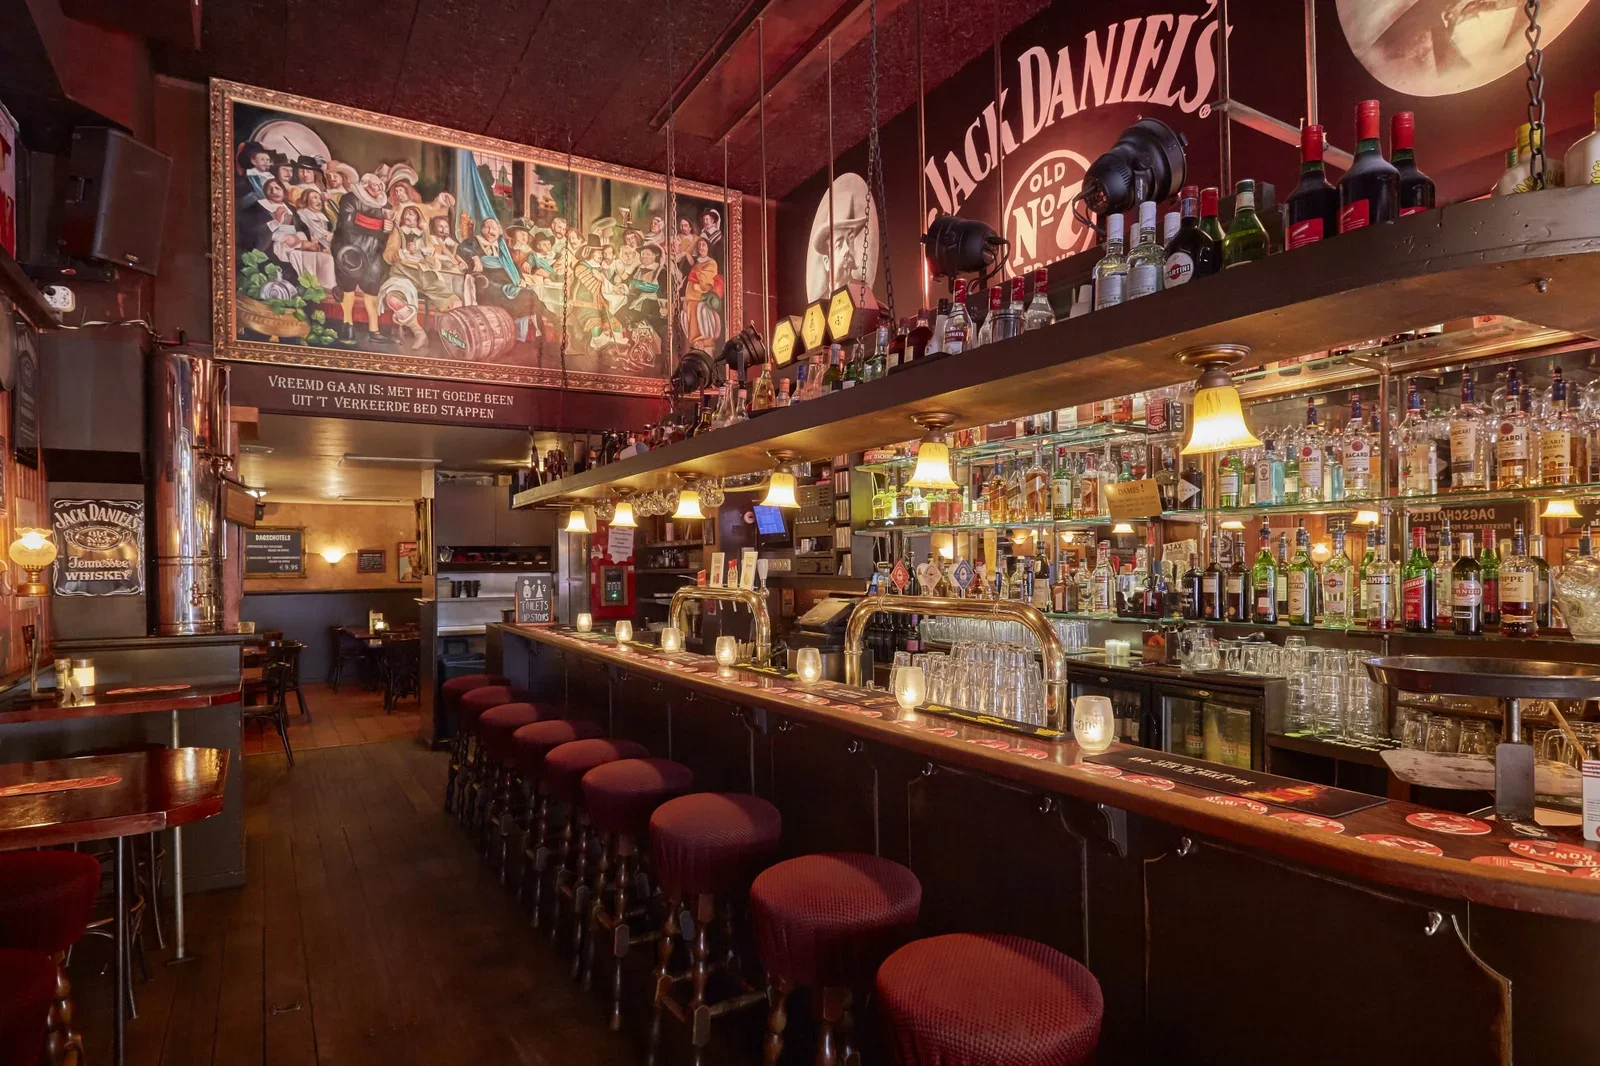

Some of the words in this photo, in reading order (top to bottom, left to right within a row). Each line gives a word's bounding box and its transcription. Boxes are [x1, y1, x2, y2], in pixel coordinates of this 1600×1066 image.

[925, 88, 1020, 226] JACK
[1029, 162, 1066, 193] OLD
[1165, 264, 1191, 279] MARTINI
[268, 375, 324, 391] VREEMD
[327, 381, 365, 395] GAAN
[369, 384, 384, 396] IS:
[387, 386, 414, 398] MET
[416, 388, 440, 400] HET
[443, 390, 481, 403] GOEDE
[484, 394, 514, 406] BEEN
[292, 394, 313, 406] UIT
[334, 396, 410, 413] VERKEERDE
[413, 403, 437, 415] BED
[441, 405, 494, 419] STAPPEN
[54, 508, 89, 529] JACK
[1165, 543, 1182, 551] AJAX
[68, 556, 129, 568] Tennessee
[65, 570, 132, 581] WHISKEY
